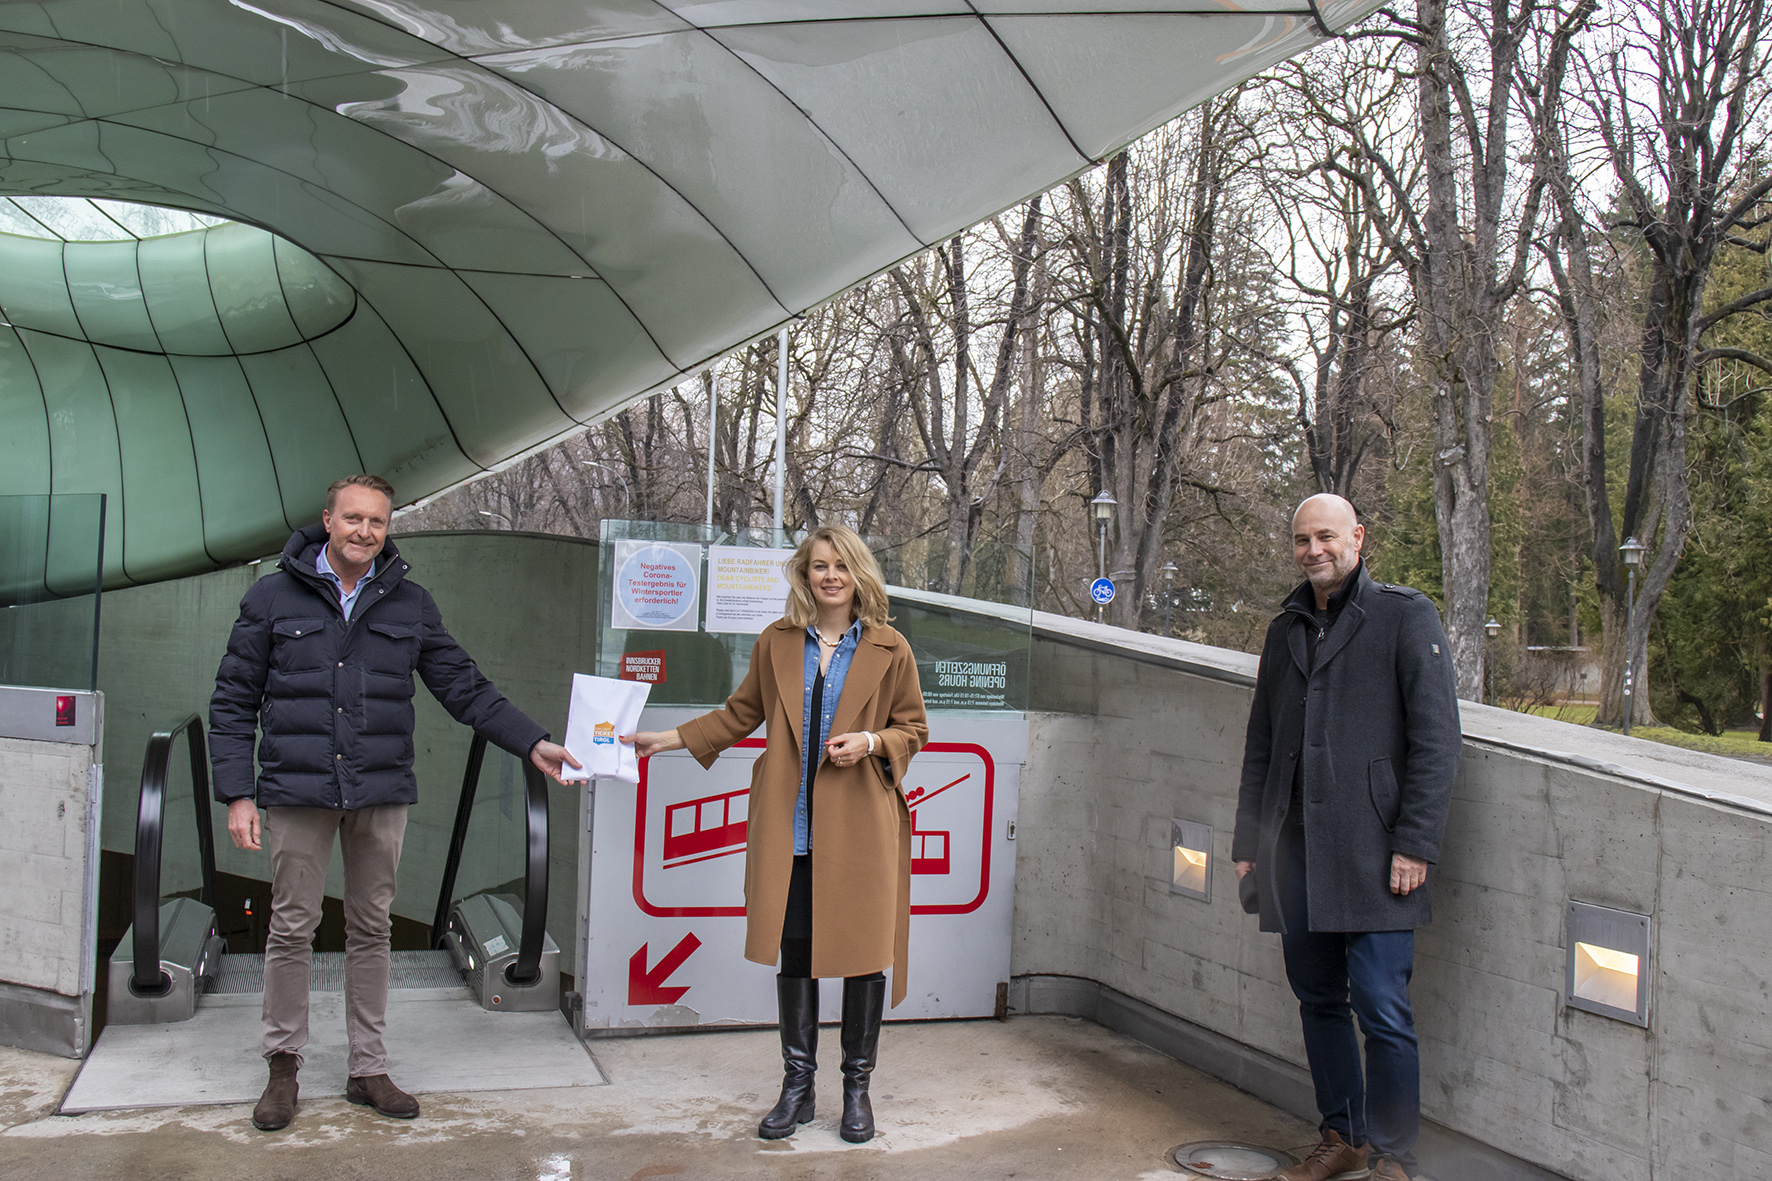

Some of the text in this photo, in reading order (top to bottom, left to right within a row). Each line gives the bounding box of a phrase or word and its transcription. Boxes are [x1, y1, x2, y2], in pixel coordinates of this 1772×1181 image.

[640, 563, 676, 571] Negatives
[717, 566, 770, 574] MOUNTAINBIKER!
[643, 571, 672, 579] Corona-
[736, 575, 765, 583] CYCLISTS
[628, 579, 674, 588] Testergebnis
[717, 583, 773, 591] MOUNTAINBIKERS!
[631, 588, 683, 596] Wintersportler
[626, 657, 661, 665] INNSBRUCKER
[626, 665, 660, 673] NORDKETTEN
